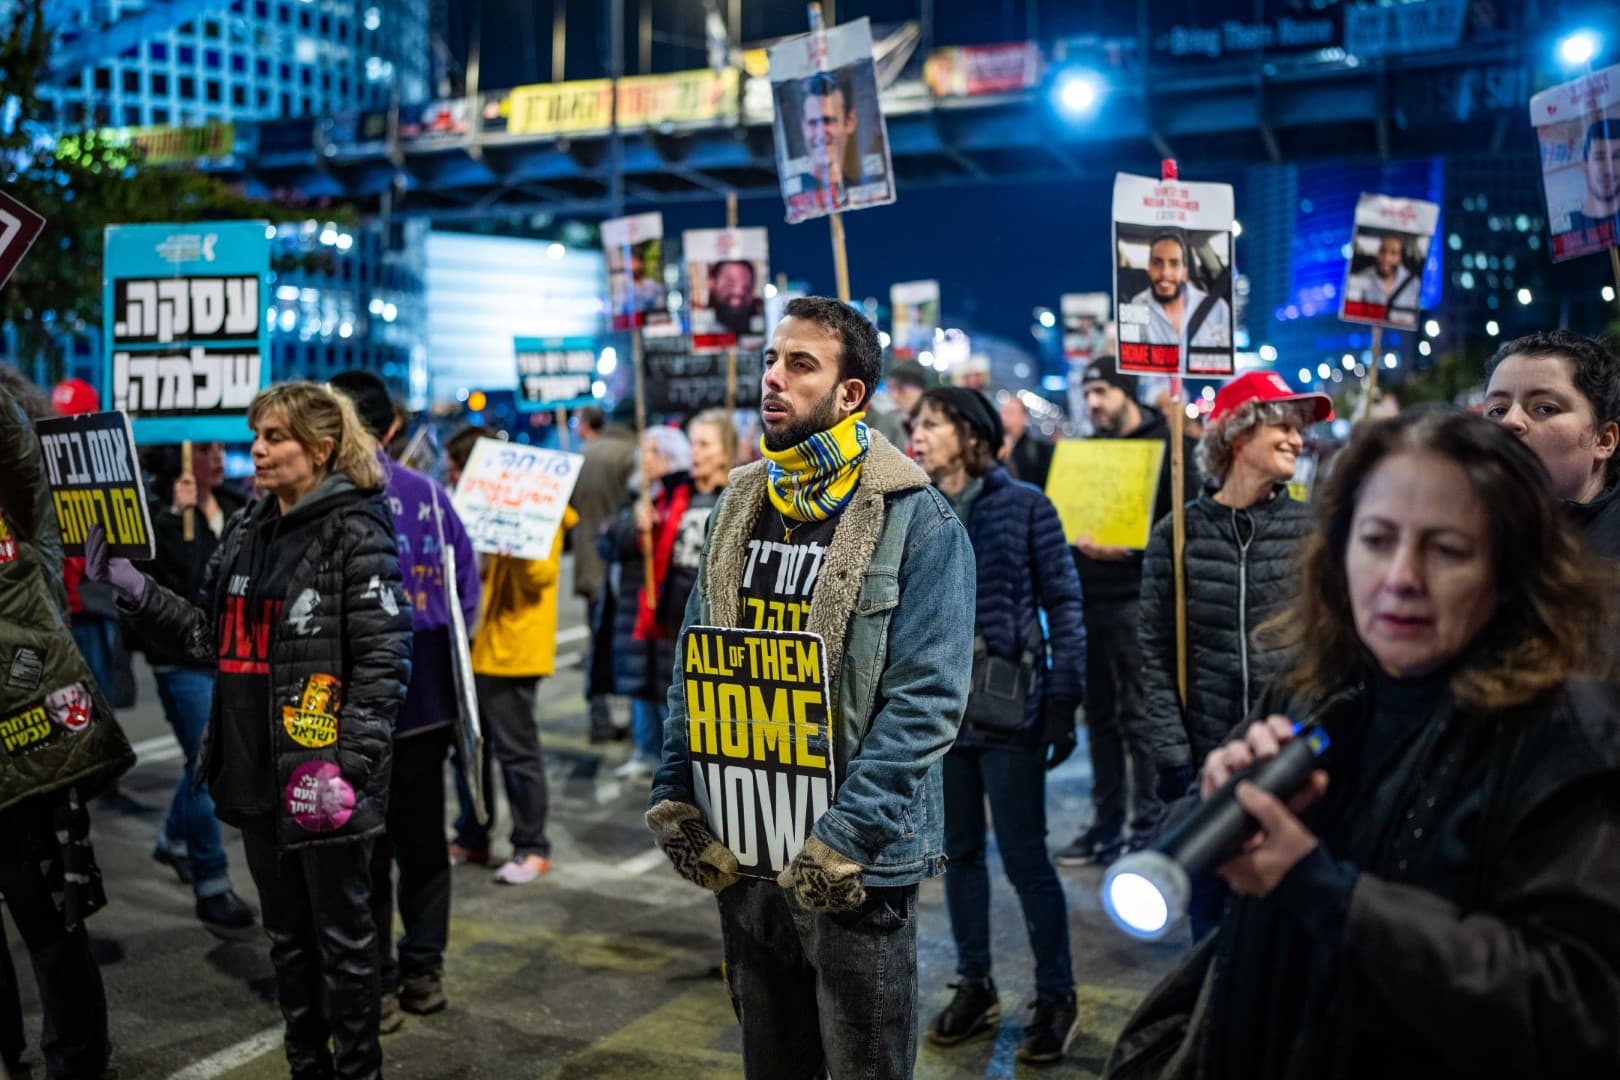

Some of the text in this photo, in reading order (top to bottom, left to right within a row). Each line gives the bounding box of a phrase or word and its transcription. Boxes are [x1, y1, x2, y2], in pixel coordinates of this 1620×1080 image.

[114, 277, 259, 343] עסקה.
[113, 346, 262, 413] שלמה!
[41, 428, 133, 486] אתם בבית
[109, 487, 146, 544] הם
[686, 633, 821, 684] ALL OF THEM
[0, 705, 47, 737] הדחה
[4, 720, 51, 752] עכשיו
[686, 679, 826, 769] HOME
